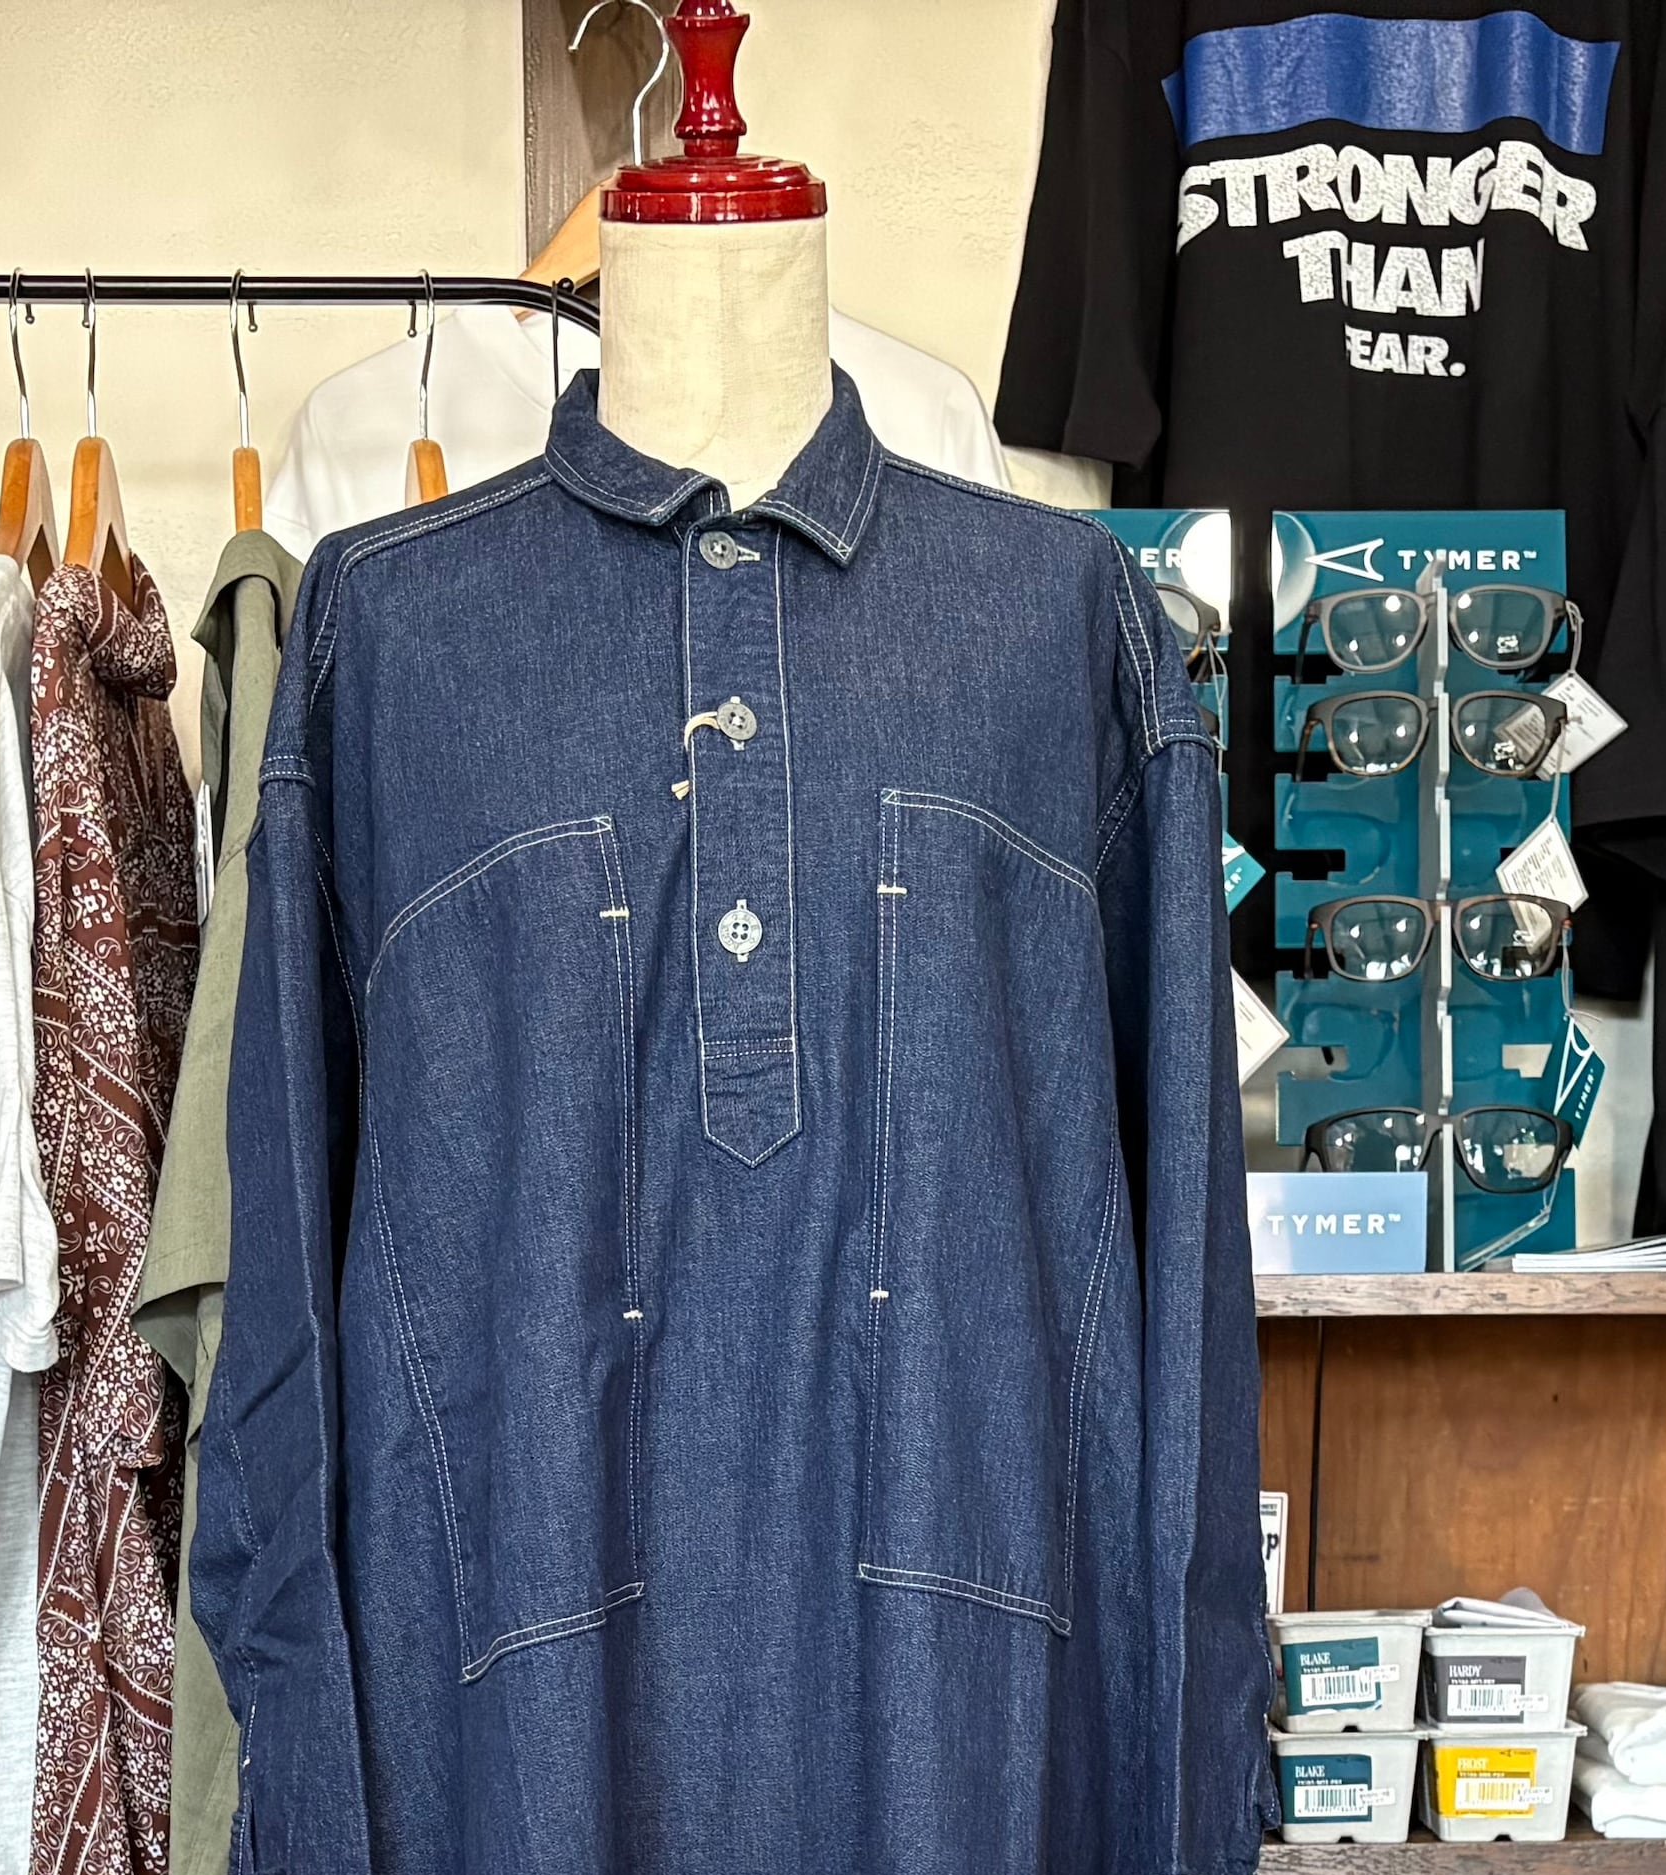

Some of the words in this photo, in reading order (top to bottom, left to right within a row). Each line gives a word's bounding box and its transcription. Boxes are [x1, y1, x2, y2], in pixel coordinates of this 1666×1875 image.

[1176, 139, 1597, 255] STRONGER
[1283, 230, 1485, 316] THAN
[1300, 1652, 1331, 1666] BLAKE
[1449, 1665, 1482, 1677] HARDY
[1295, 1765, 1325, 1778] BLAKE
